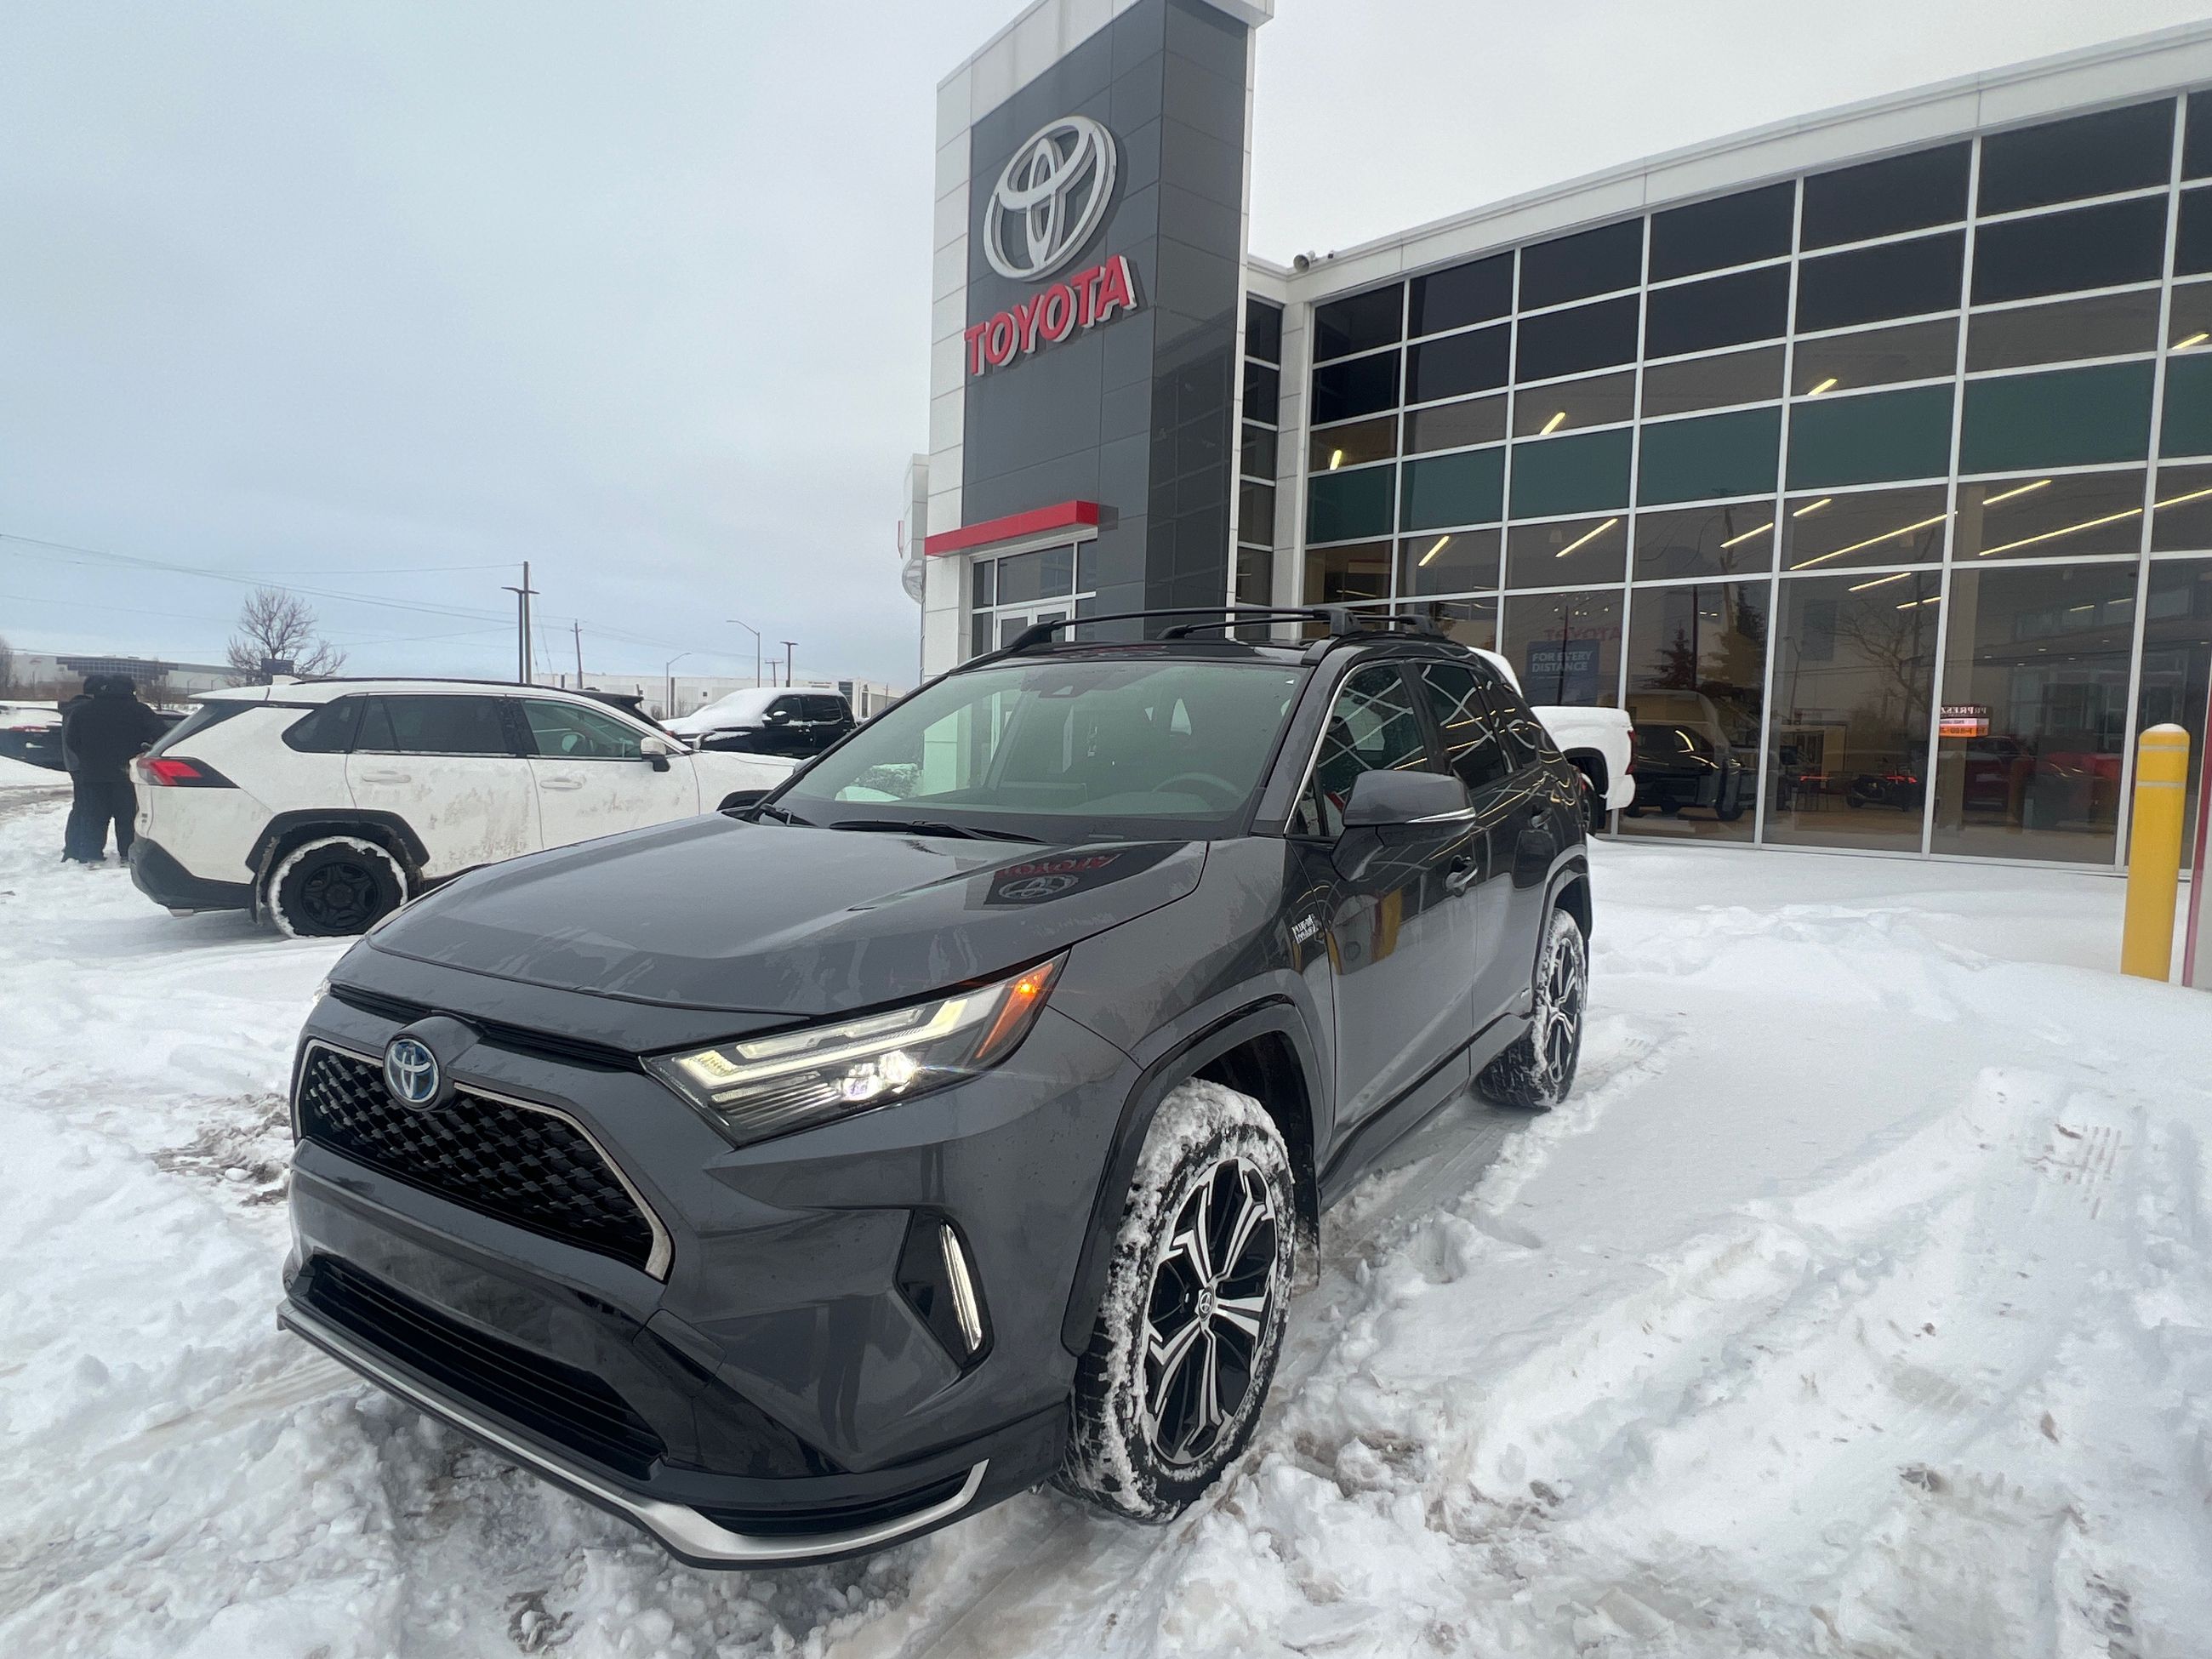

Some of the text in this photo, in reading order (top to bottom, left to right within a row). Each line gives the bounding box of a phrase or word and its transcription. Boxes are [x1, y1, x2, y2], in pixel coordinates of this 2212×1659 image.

[964, 254, 1137, 376] TOYOTA
[1531, 650, 1593, 662] FOR EVERY
[1531, 661, 1588, 672] DISTANCE
